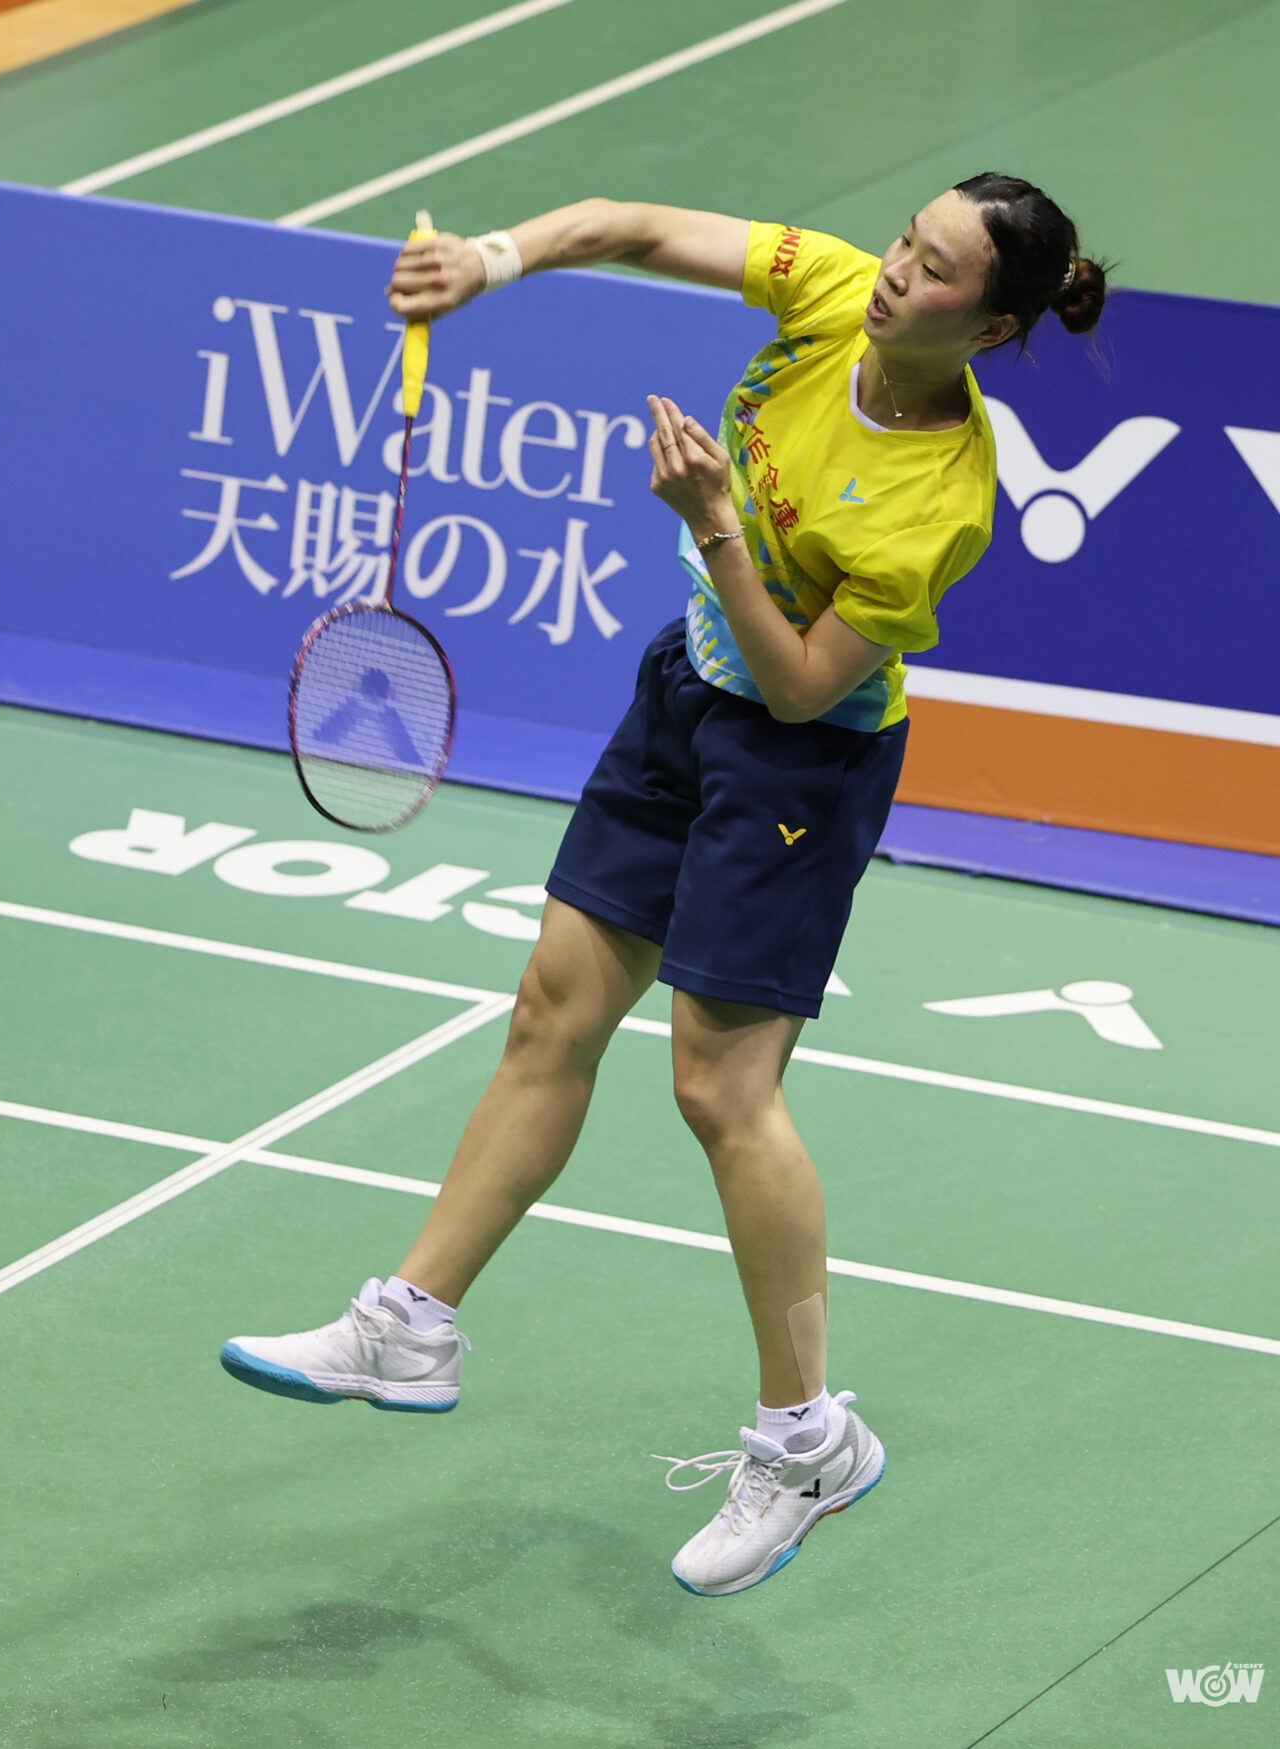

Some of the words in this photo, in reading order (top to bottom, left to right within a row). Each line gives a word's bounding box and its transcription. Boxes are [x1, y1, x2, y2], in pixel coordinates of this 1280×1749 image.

[188, 296, 647, 508] iWater
[169, 467, 629, 646] 天賜の水
